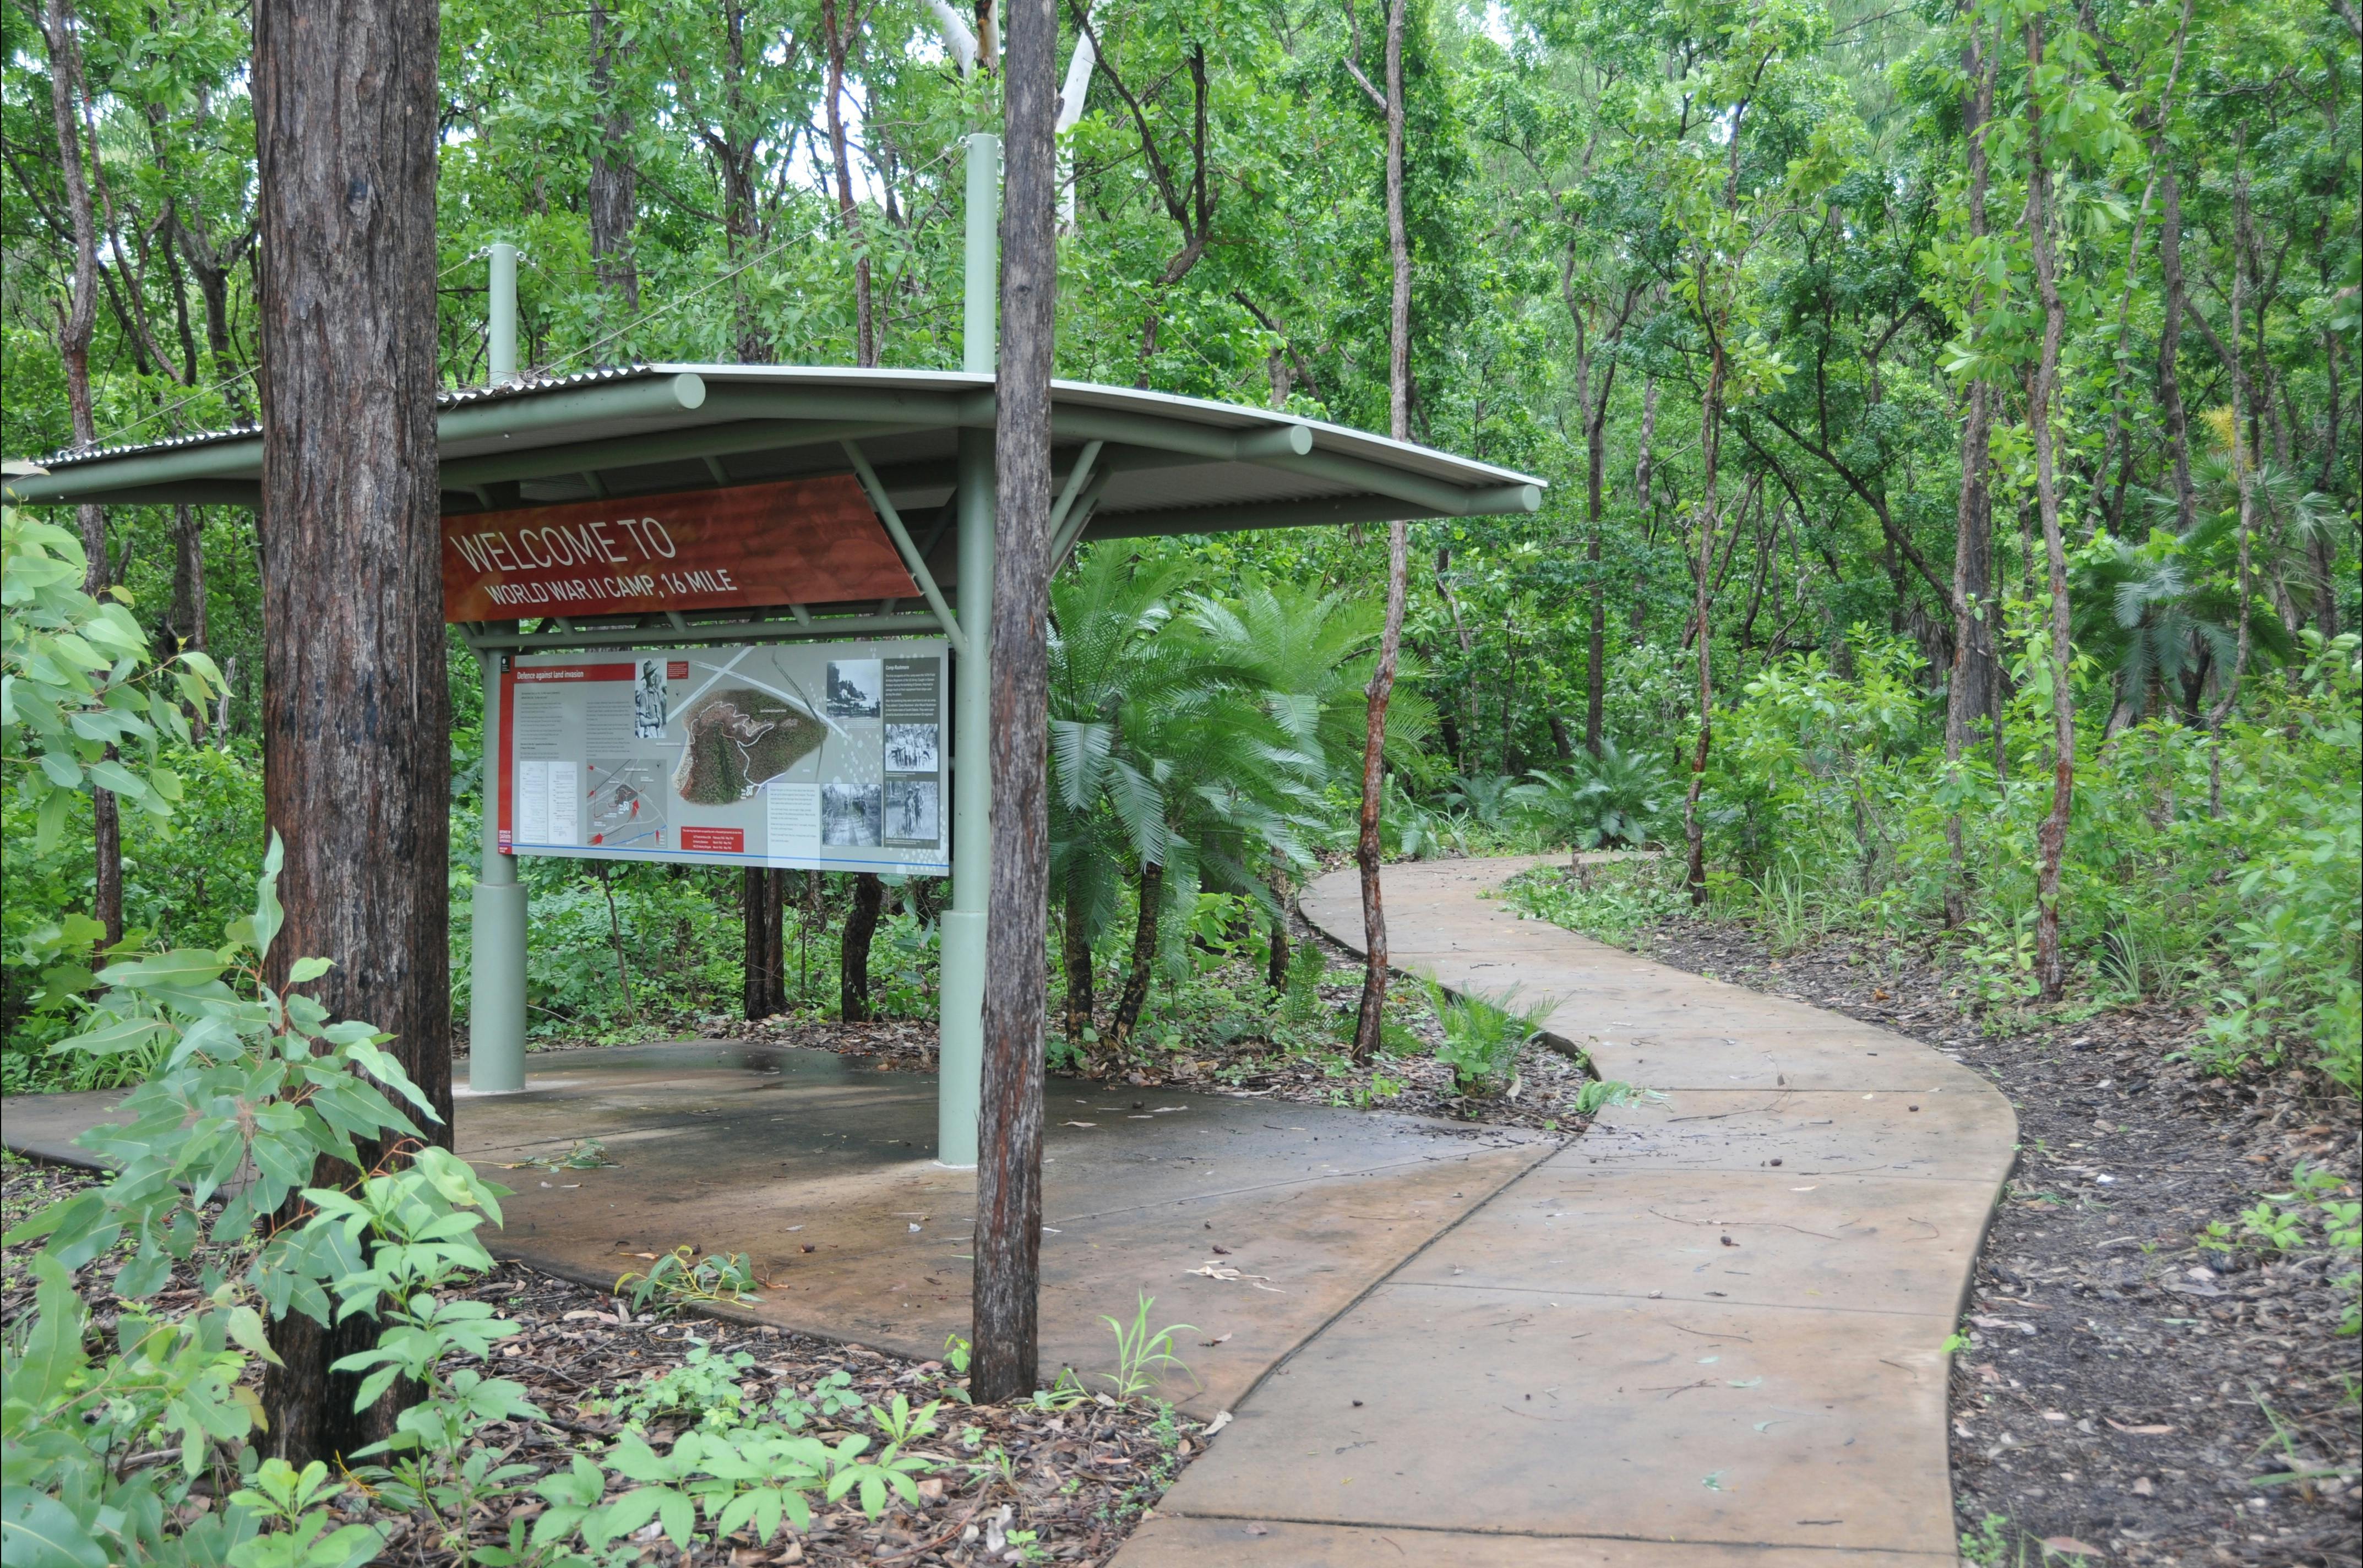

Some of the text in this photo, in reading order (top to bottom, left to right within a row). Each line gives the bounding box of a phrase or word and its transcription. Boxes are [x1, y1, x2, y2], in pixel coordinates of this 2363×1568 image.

[449, 517, 676, 573] WELCOME TO
[484, 583, 549, 605] WORLD
[545, 579, 592, 601] WAR
[588, 579, 607, 598] II
[661, 573, 687, 594] 16
[684, 569, 738, 593] MILE
[536, 671, 553, 680] against
